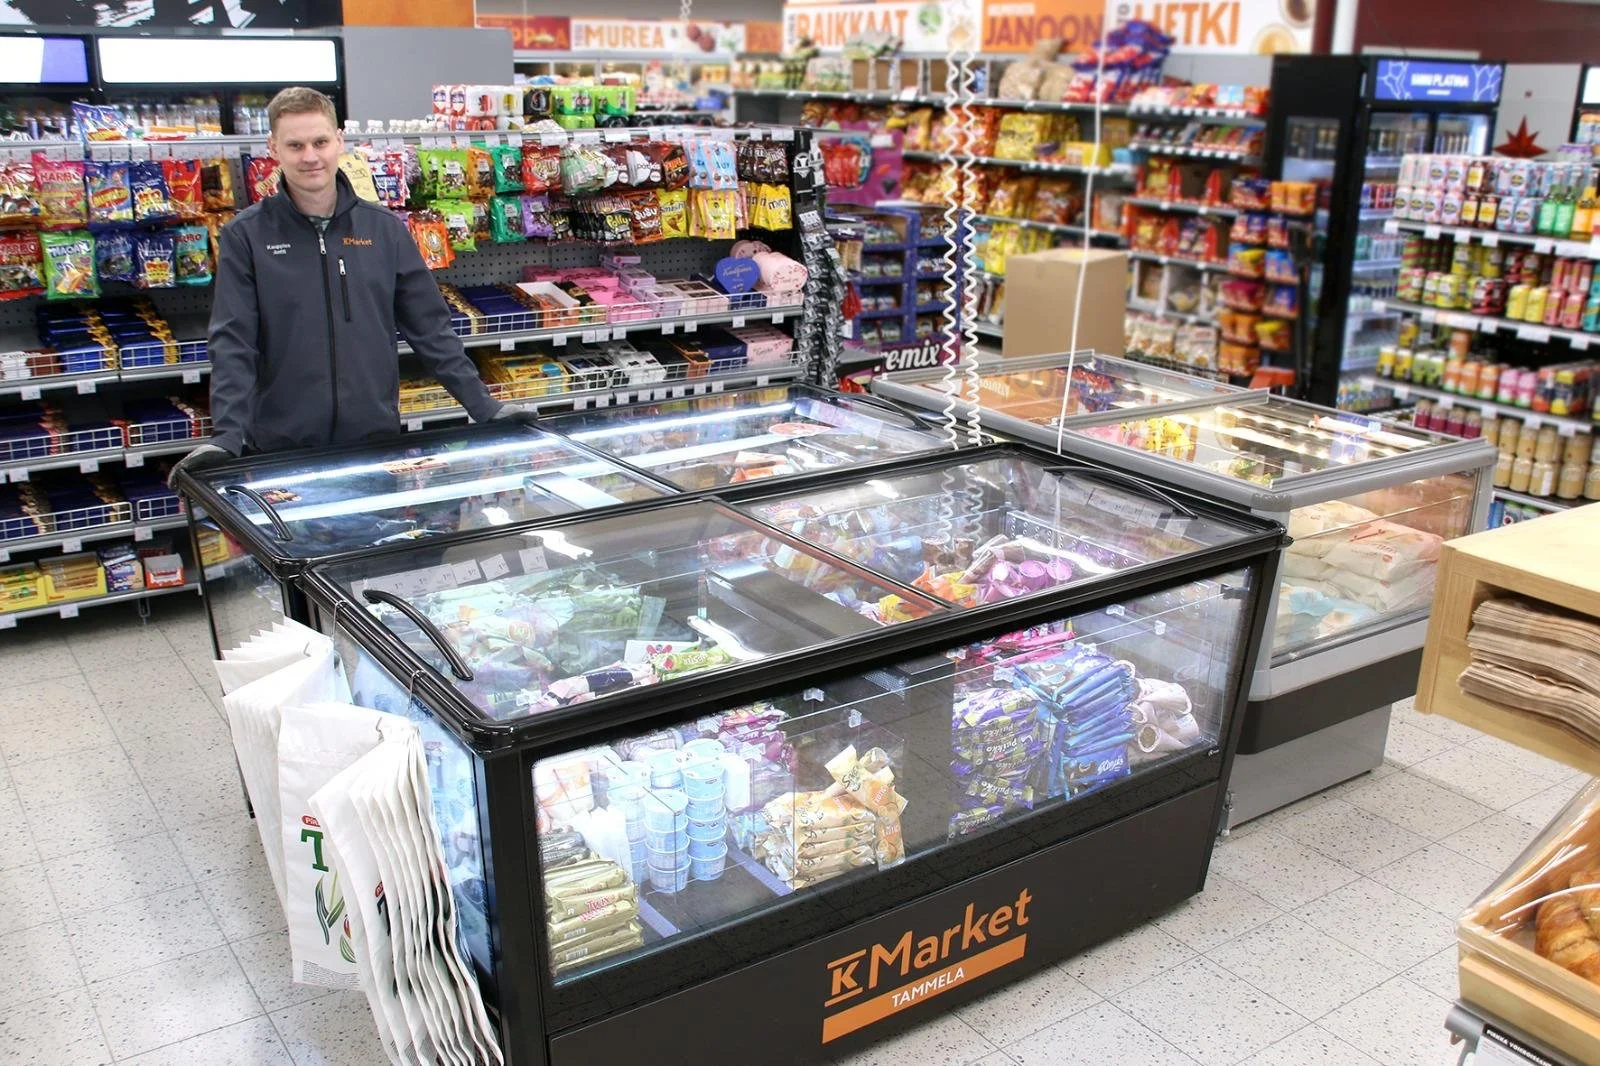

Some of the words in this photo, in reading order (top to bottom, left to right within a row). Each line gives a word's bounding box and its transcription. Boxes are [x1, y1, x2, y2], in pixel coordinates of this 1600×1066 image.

[584, 24, 665, 48] MUREA
[984, 14, 1105, 46] JANOON
[892, 967, 965, 1008] TAMMELA
